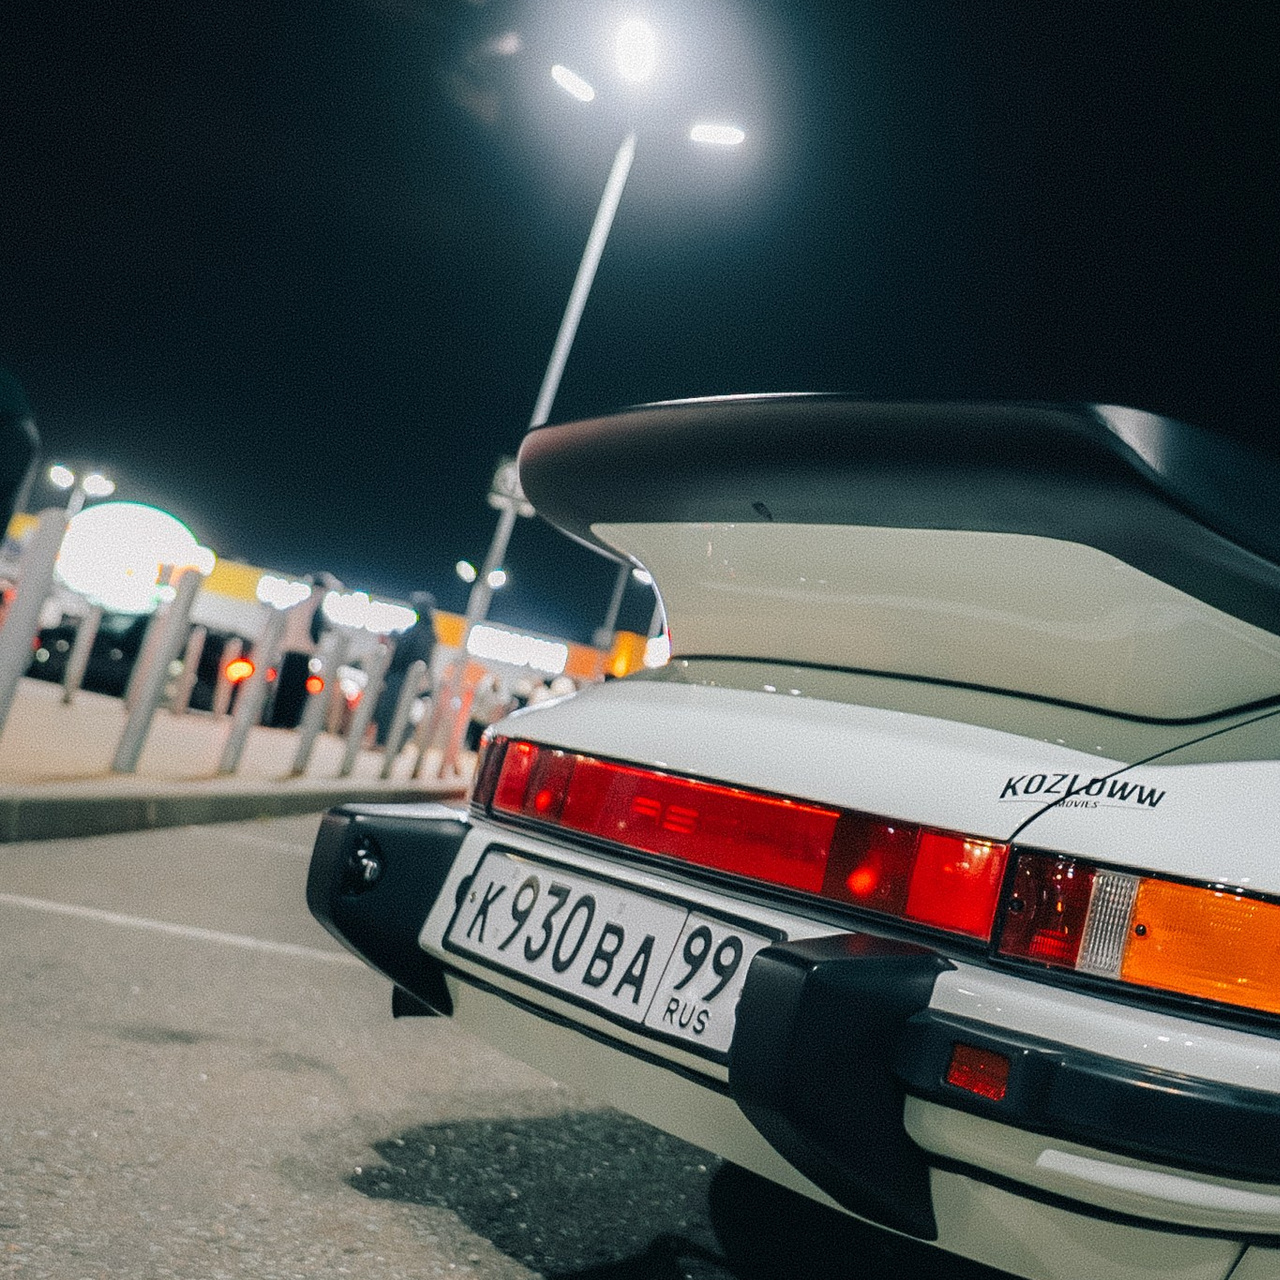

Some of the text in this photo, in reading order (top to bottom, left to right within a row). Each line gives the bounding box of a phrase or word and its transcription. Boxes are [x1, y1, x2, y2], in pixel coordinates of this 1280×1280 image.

[999, 773, 1166, 808] KOZLOWW
[673, 925, 744, 1002] 99
[662, 997, 710, 1035] RUS
